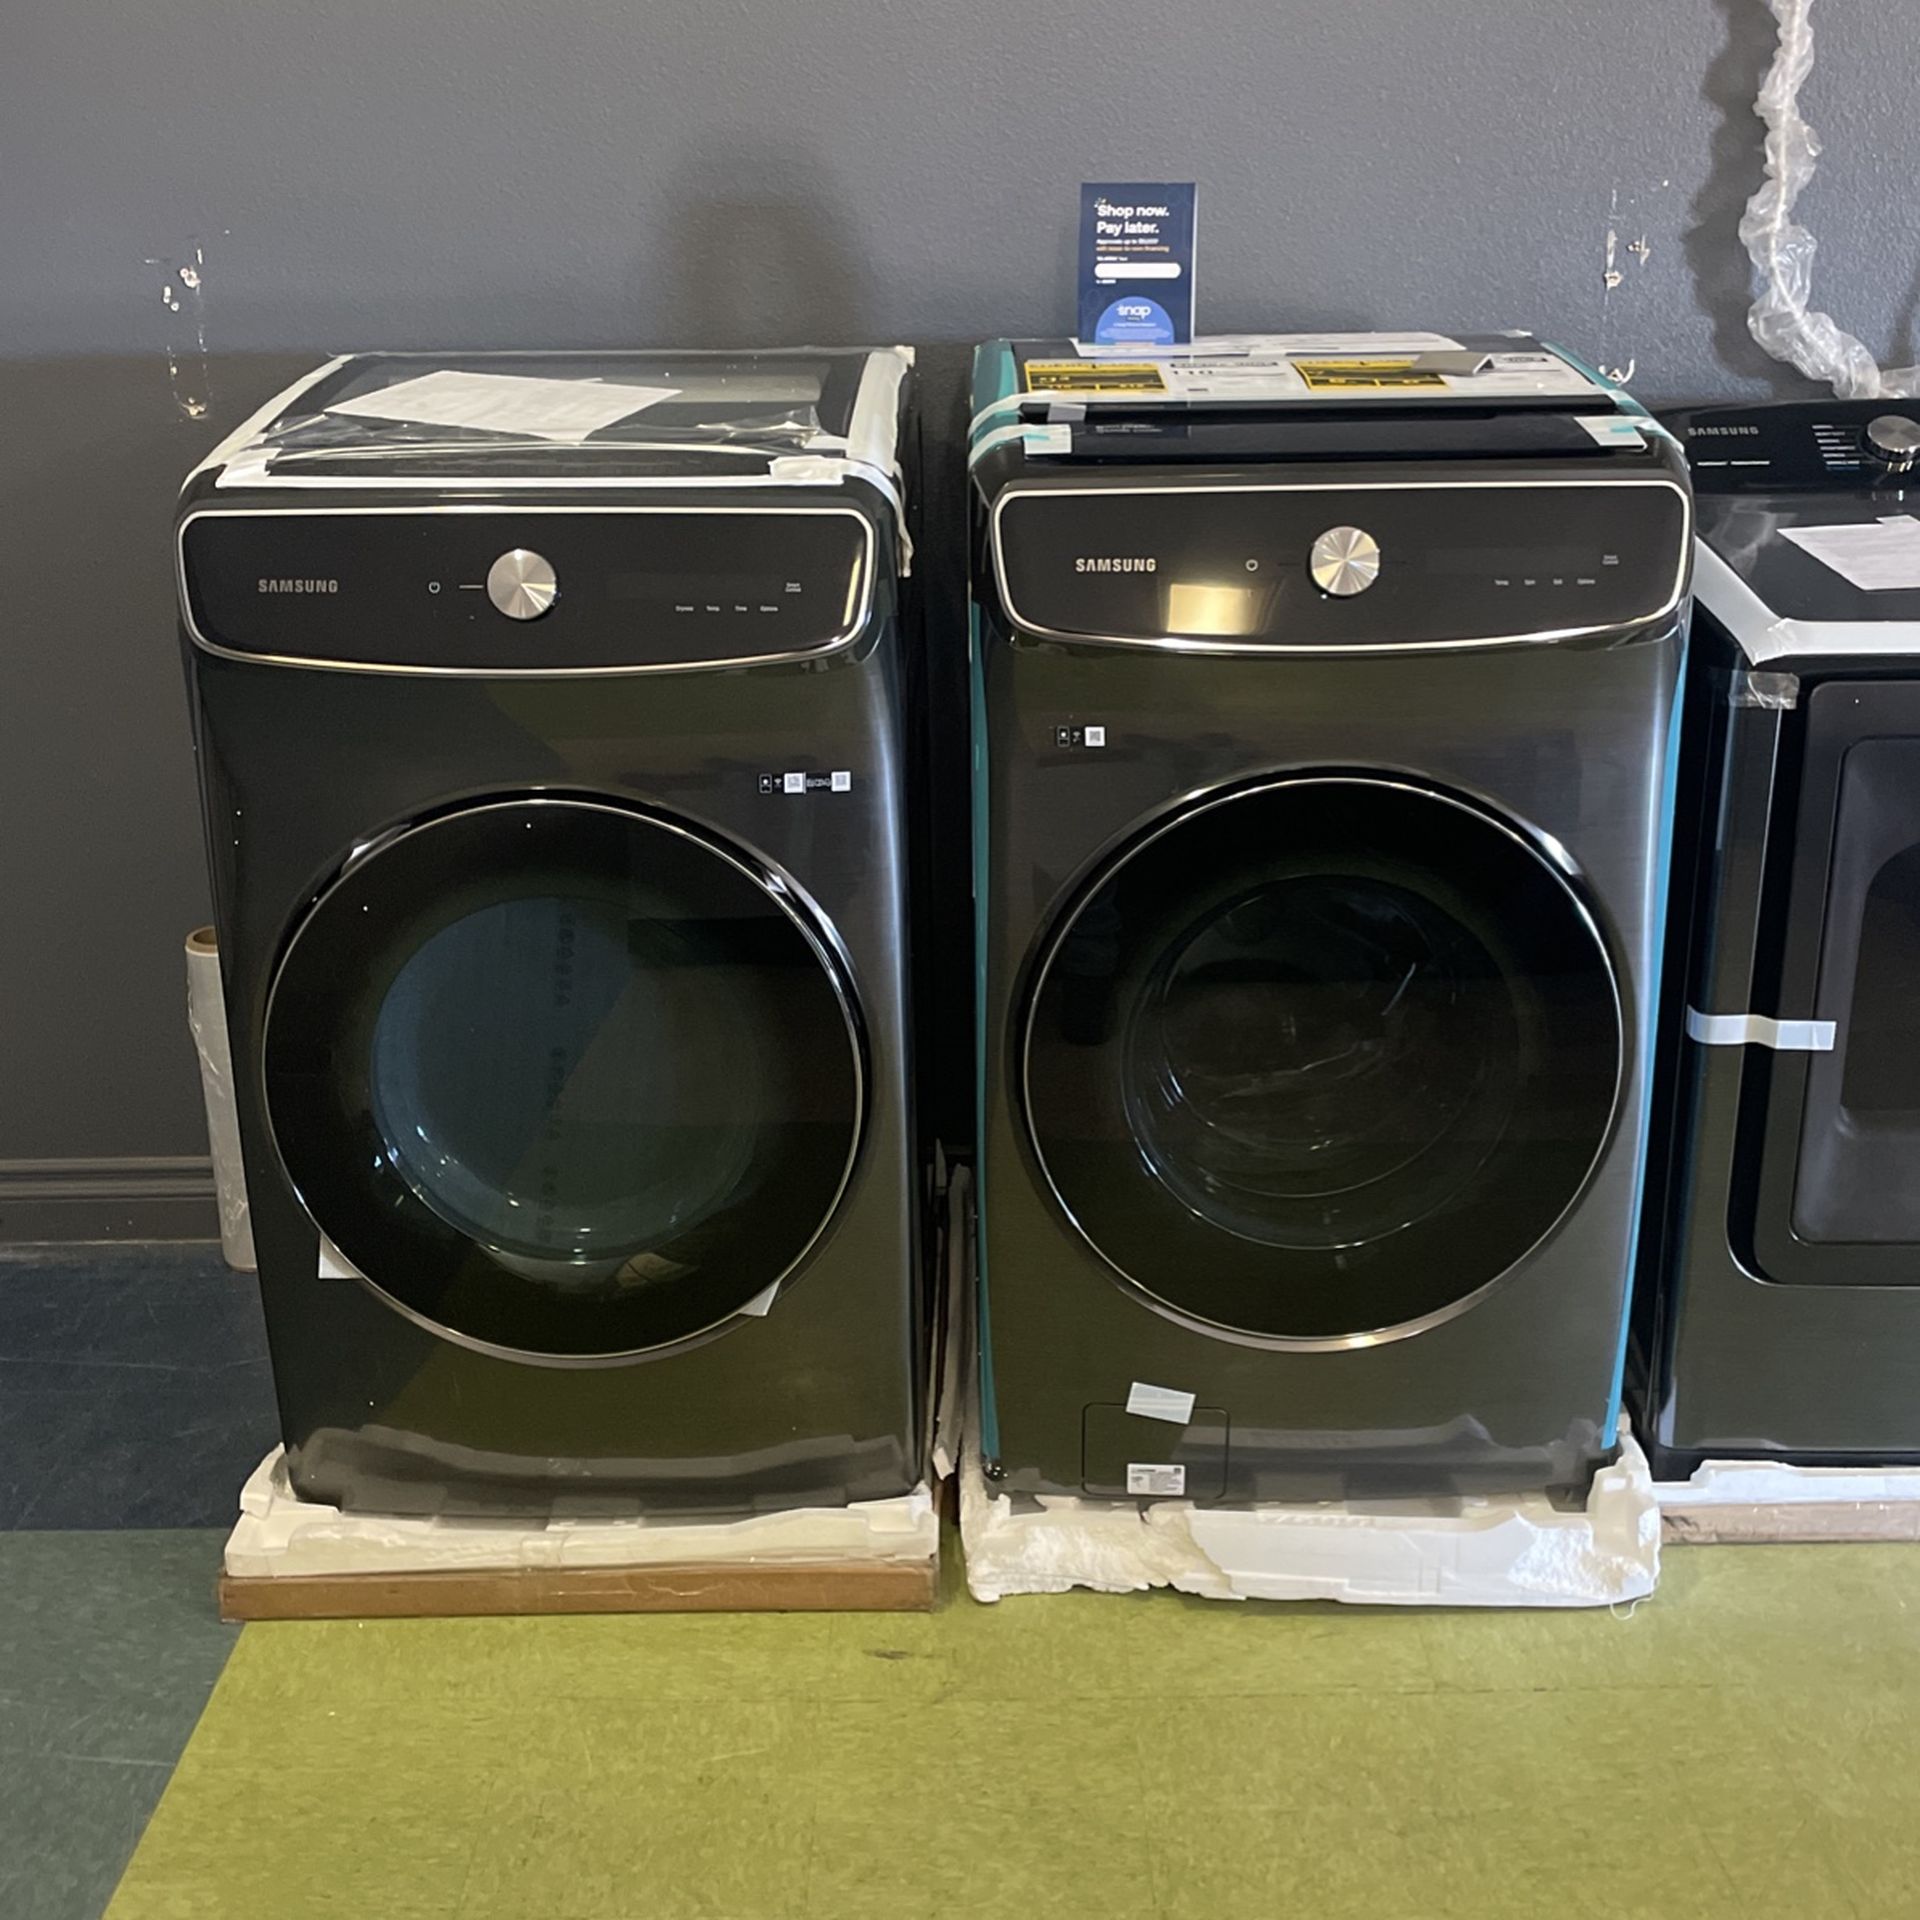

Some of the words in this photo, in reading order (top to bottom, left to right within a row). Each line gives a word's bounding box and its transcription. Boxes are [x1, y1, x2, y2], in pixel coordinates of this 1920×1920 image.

[1097, 204, 1134, 219] Shop
[1136, 206, 1170, 217] now.
[1096, 221, 1122, 237] Pay
[1124, 221, 1159, 234] later.
[1687, 426, 1760, 436] SAMSUNG
[1075, 558, 1156, 572] SAMSUNG
[258, 579, 338, 593] SAMSUNG
